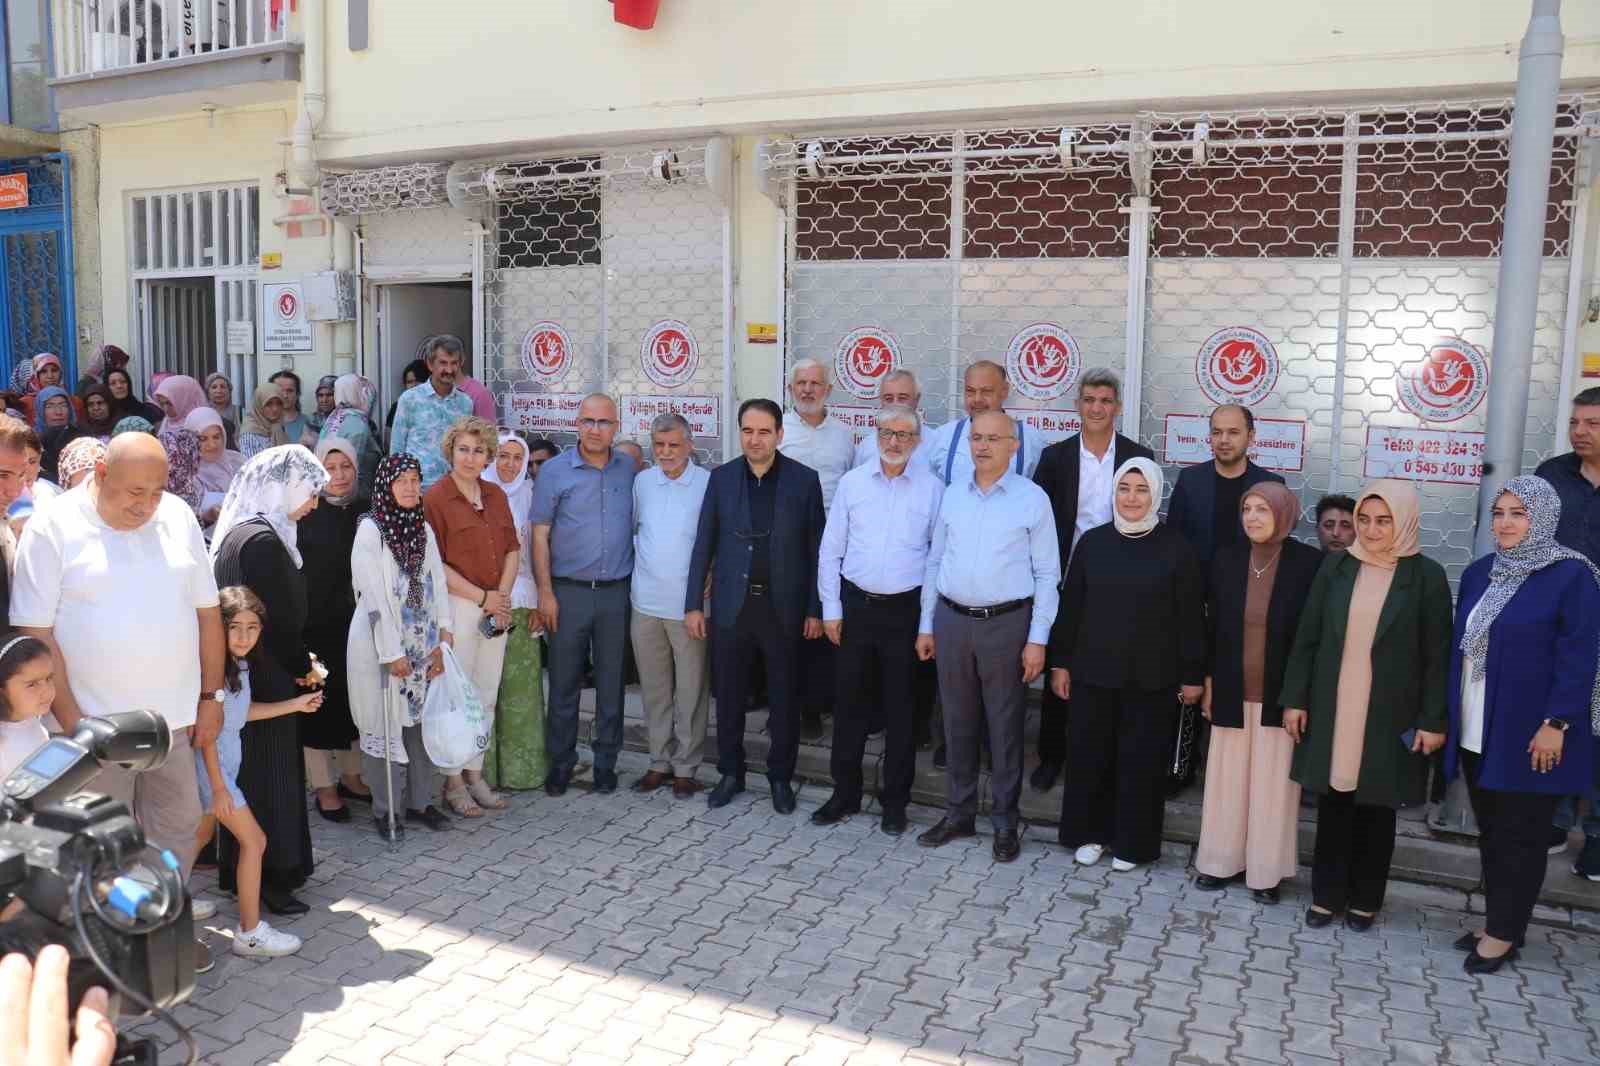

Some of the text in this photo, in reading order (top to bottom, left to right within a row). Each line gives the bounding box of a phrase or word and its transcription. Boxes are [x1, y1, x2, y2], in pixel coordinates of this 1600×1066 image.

[1444, 440, 1468, 456] 324
[1404, 460, 1412, 473] 0
[1415, 460, 1439, 475] 545
